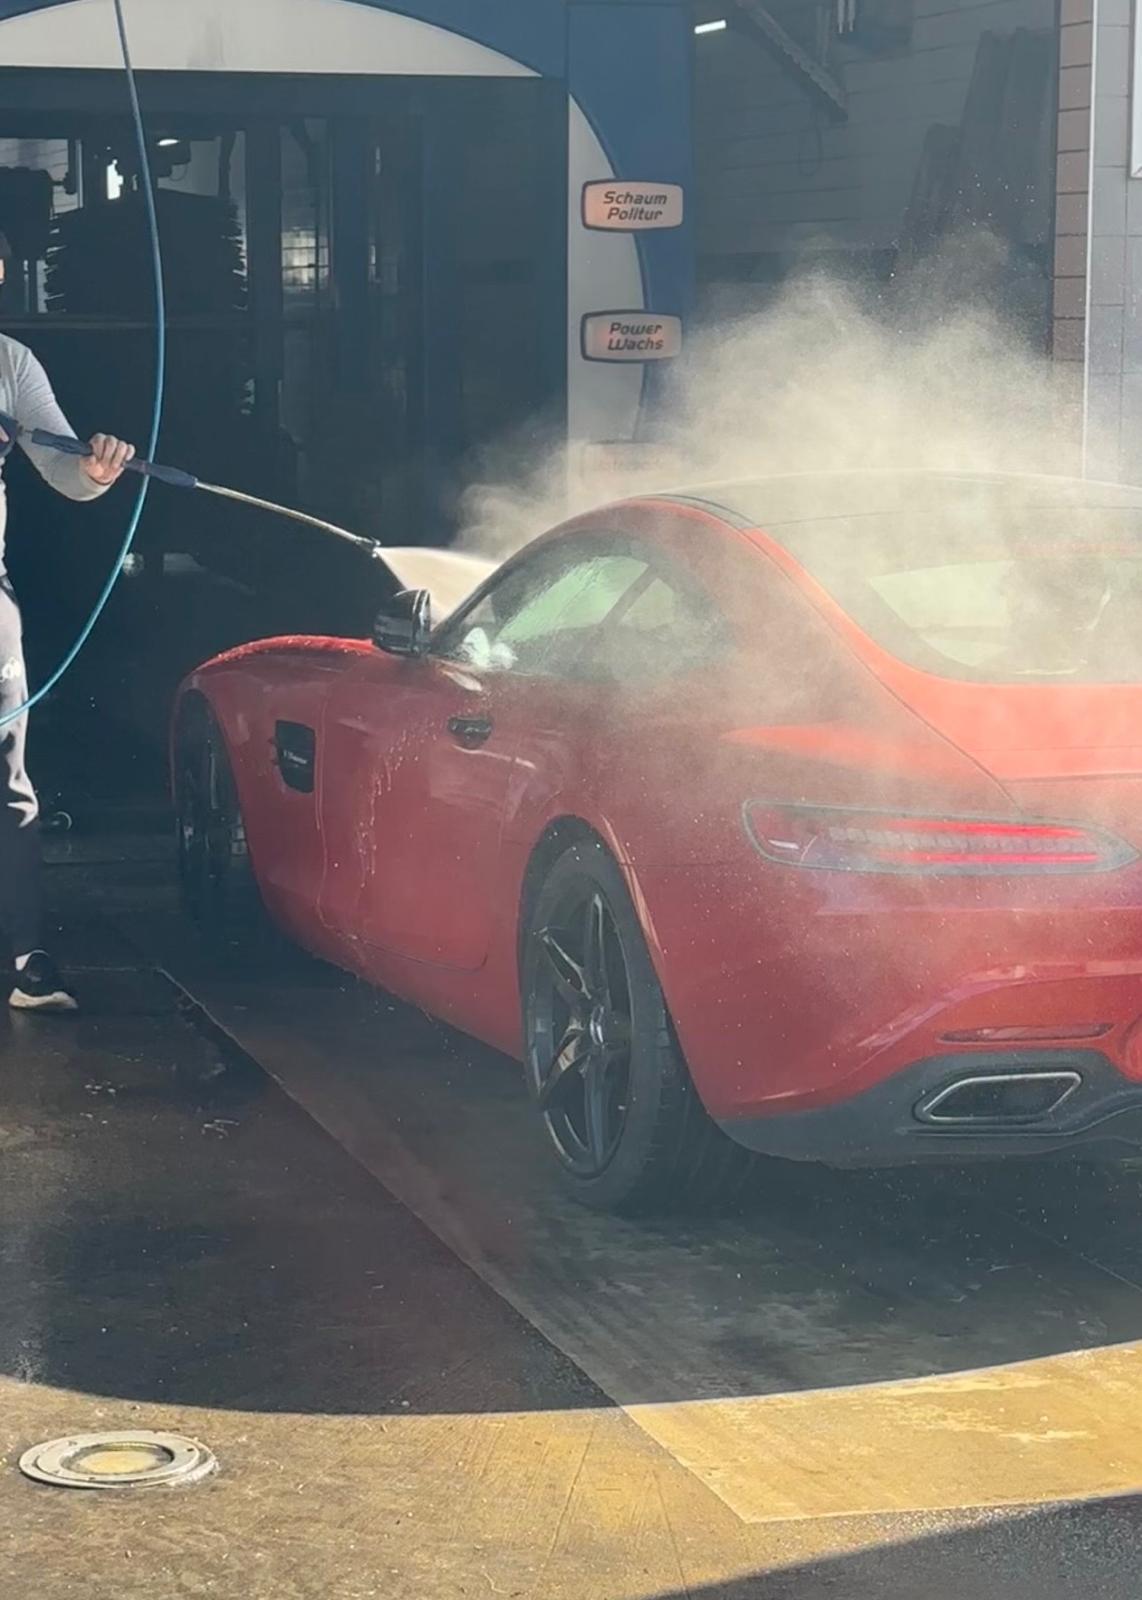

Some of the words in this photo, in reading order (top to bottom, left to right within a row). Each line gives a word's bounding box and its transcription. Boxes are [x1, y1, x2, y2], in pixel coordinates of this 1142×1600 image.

[603, 191, 668, 205] Schaum
[607, 207, 663, 221] Politur
[609, 322, 663, 335] Power
[607, 338, 664, 351] Wachs
